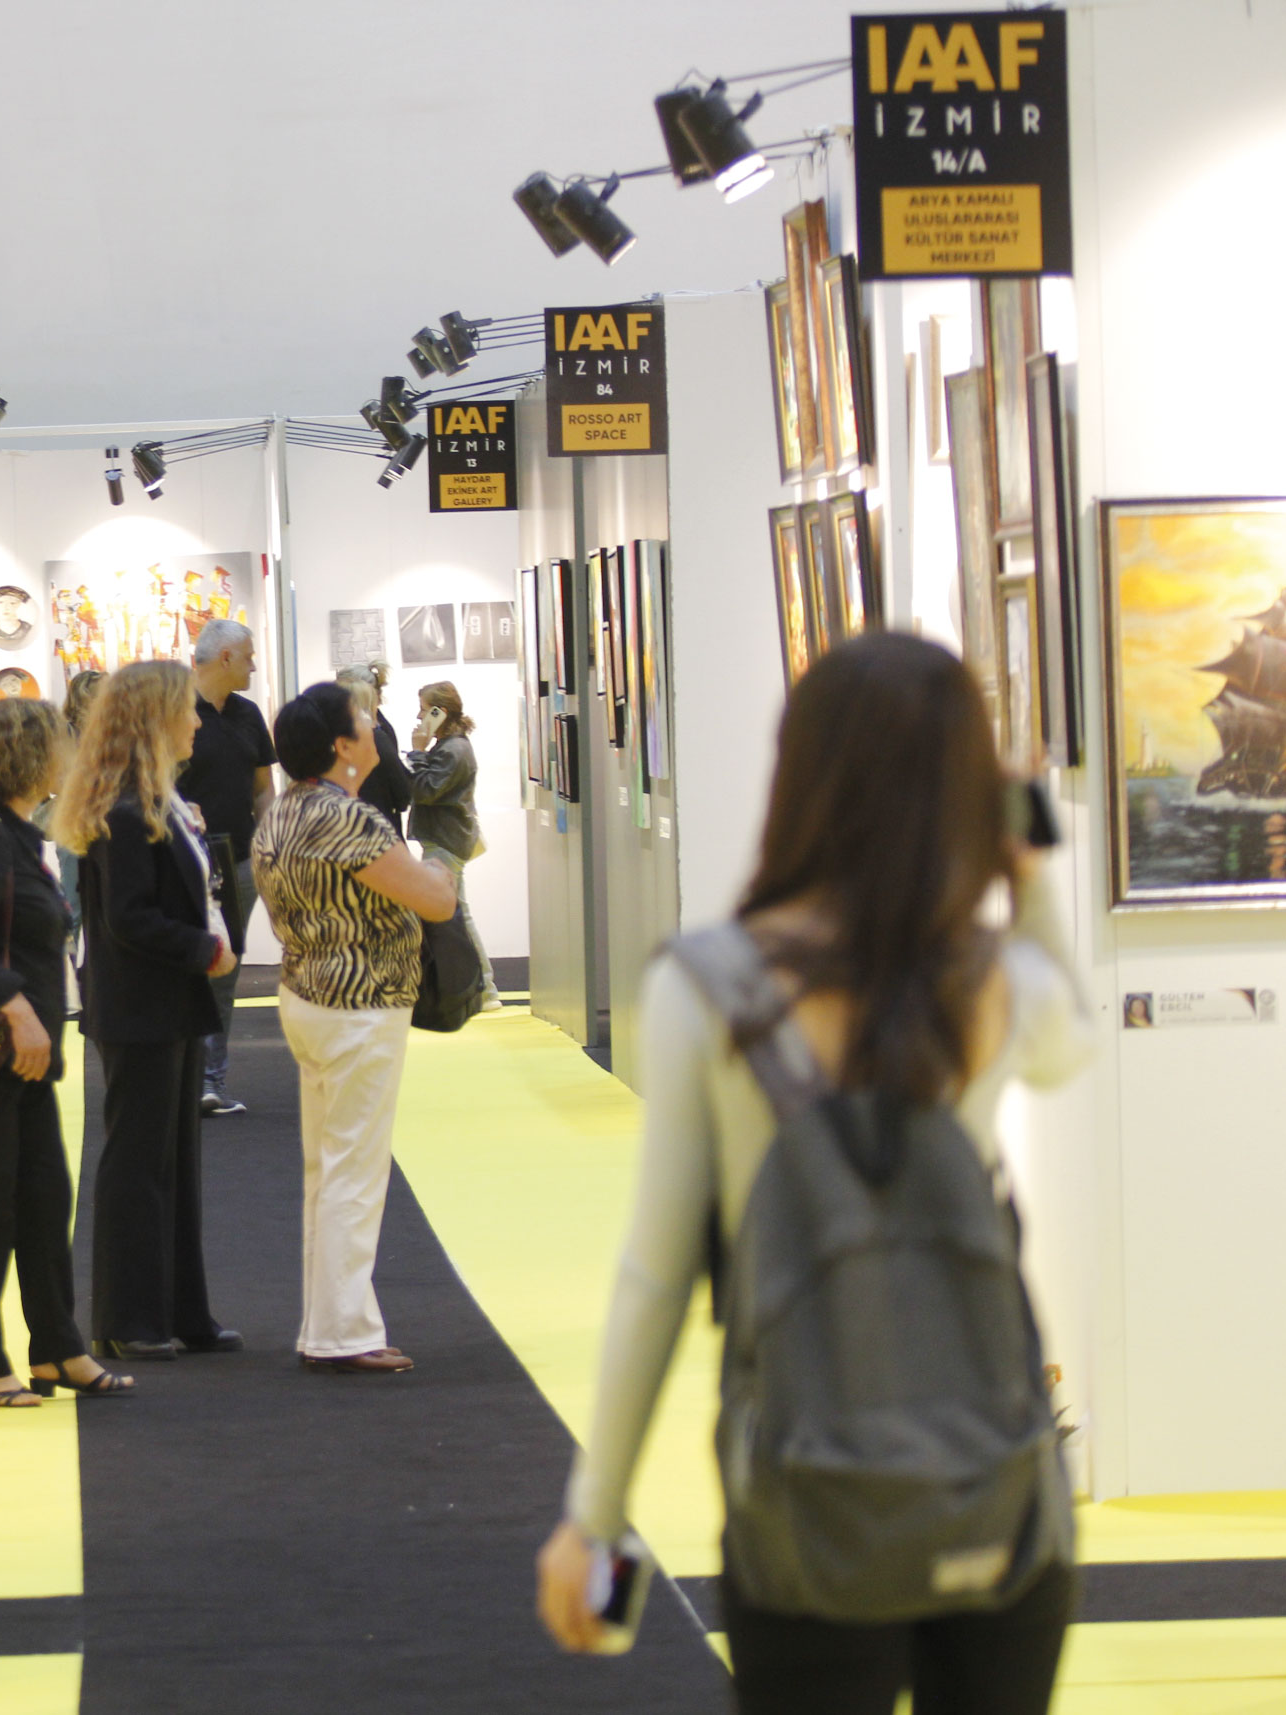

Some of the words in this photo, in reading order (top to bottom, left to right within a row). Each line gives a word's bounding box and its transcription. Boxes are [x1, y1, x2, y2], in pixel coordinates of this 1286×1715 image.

[868, 22, 1044, 93] IAAF
[875, 100, 1041, 138] İZMİR
[932, 148, 987, 175] 14/A
[908, 192, 951, 207] ARYA
[969, 230, 1019, 245] SANAT
[553, 313, 652, 351] IAAF
[559, 356, 650, 375] İZMİR
[596, 384, 614, 396] 84
[434, 406, 507, 435] IAAF
[568, 414, 614, 425] ROSSO
[618, 413, 642, 424] ART
[585, 430, 627, 441] SPACE
[437, 438, 506, 453] İZMİR
[466, 458, 477, 468] 13
[454, 476, 491, 484] HAYDAR
[481, 486, 498, 494] ART
[454, 497, 493, 506] GALLERY
